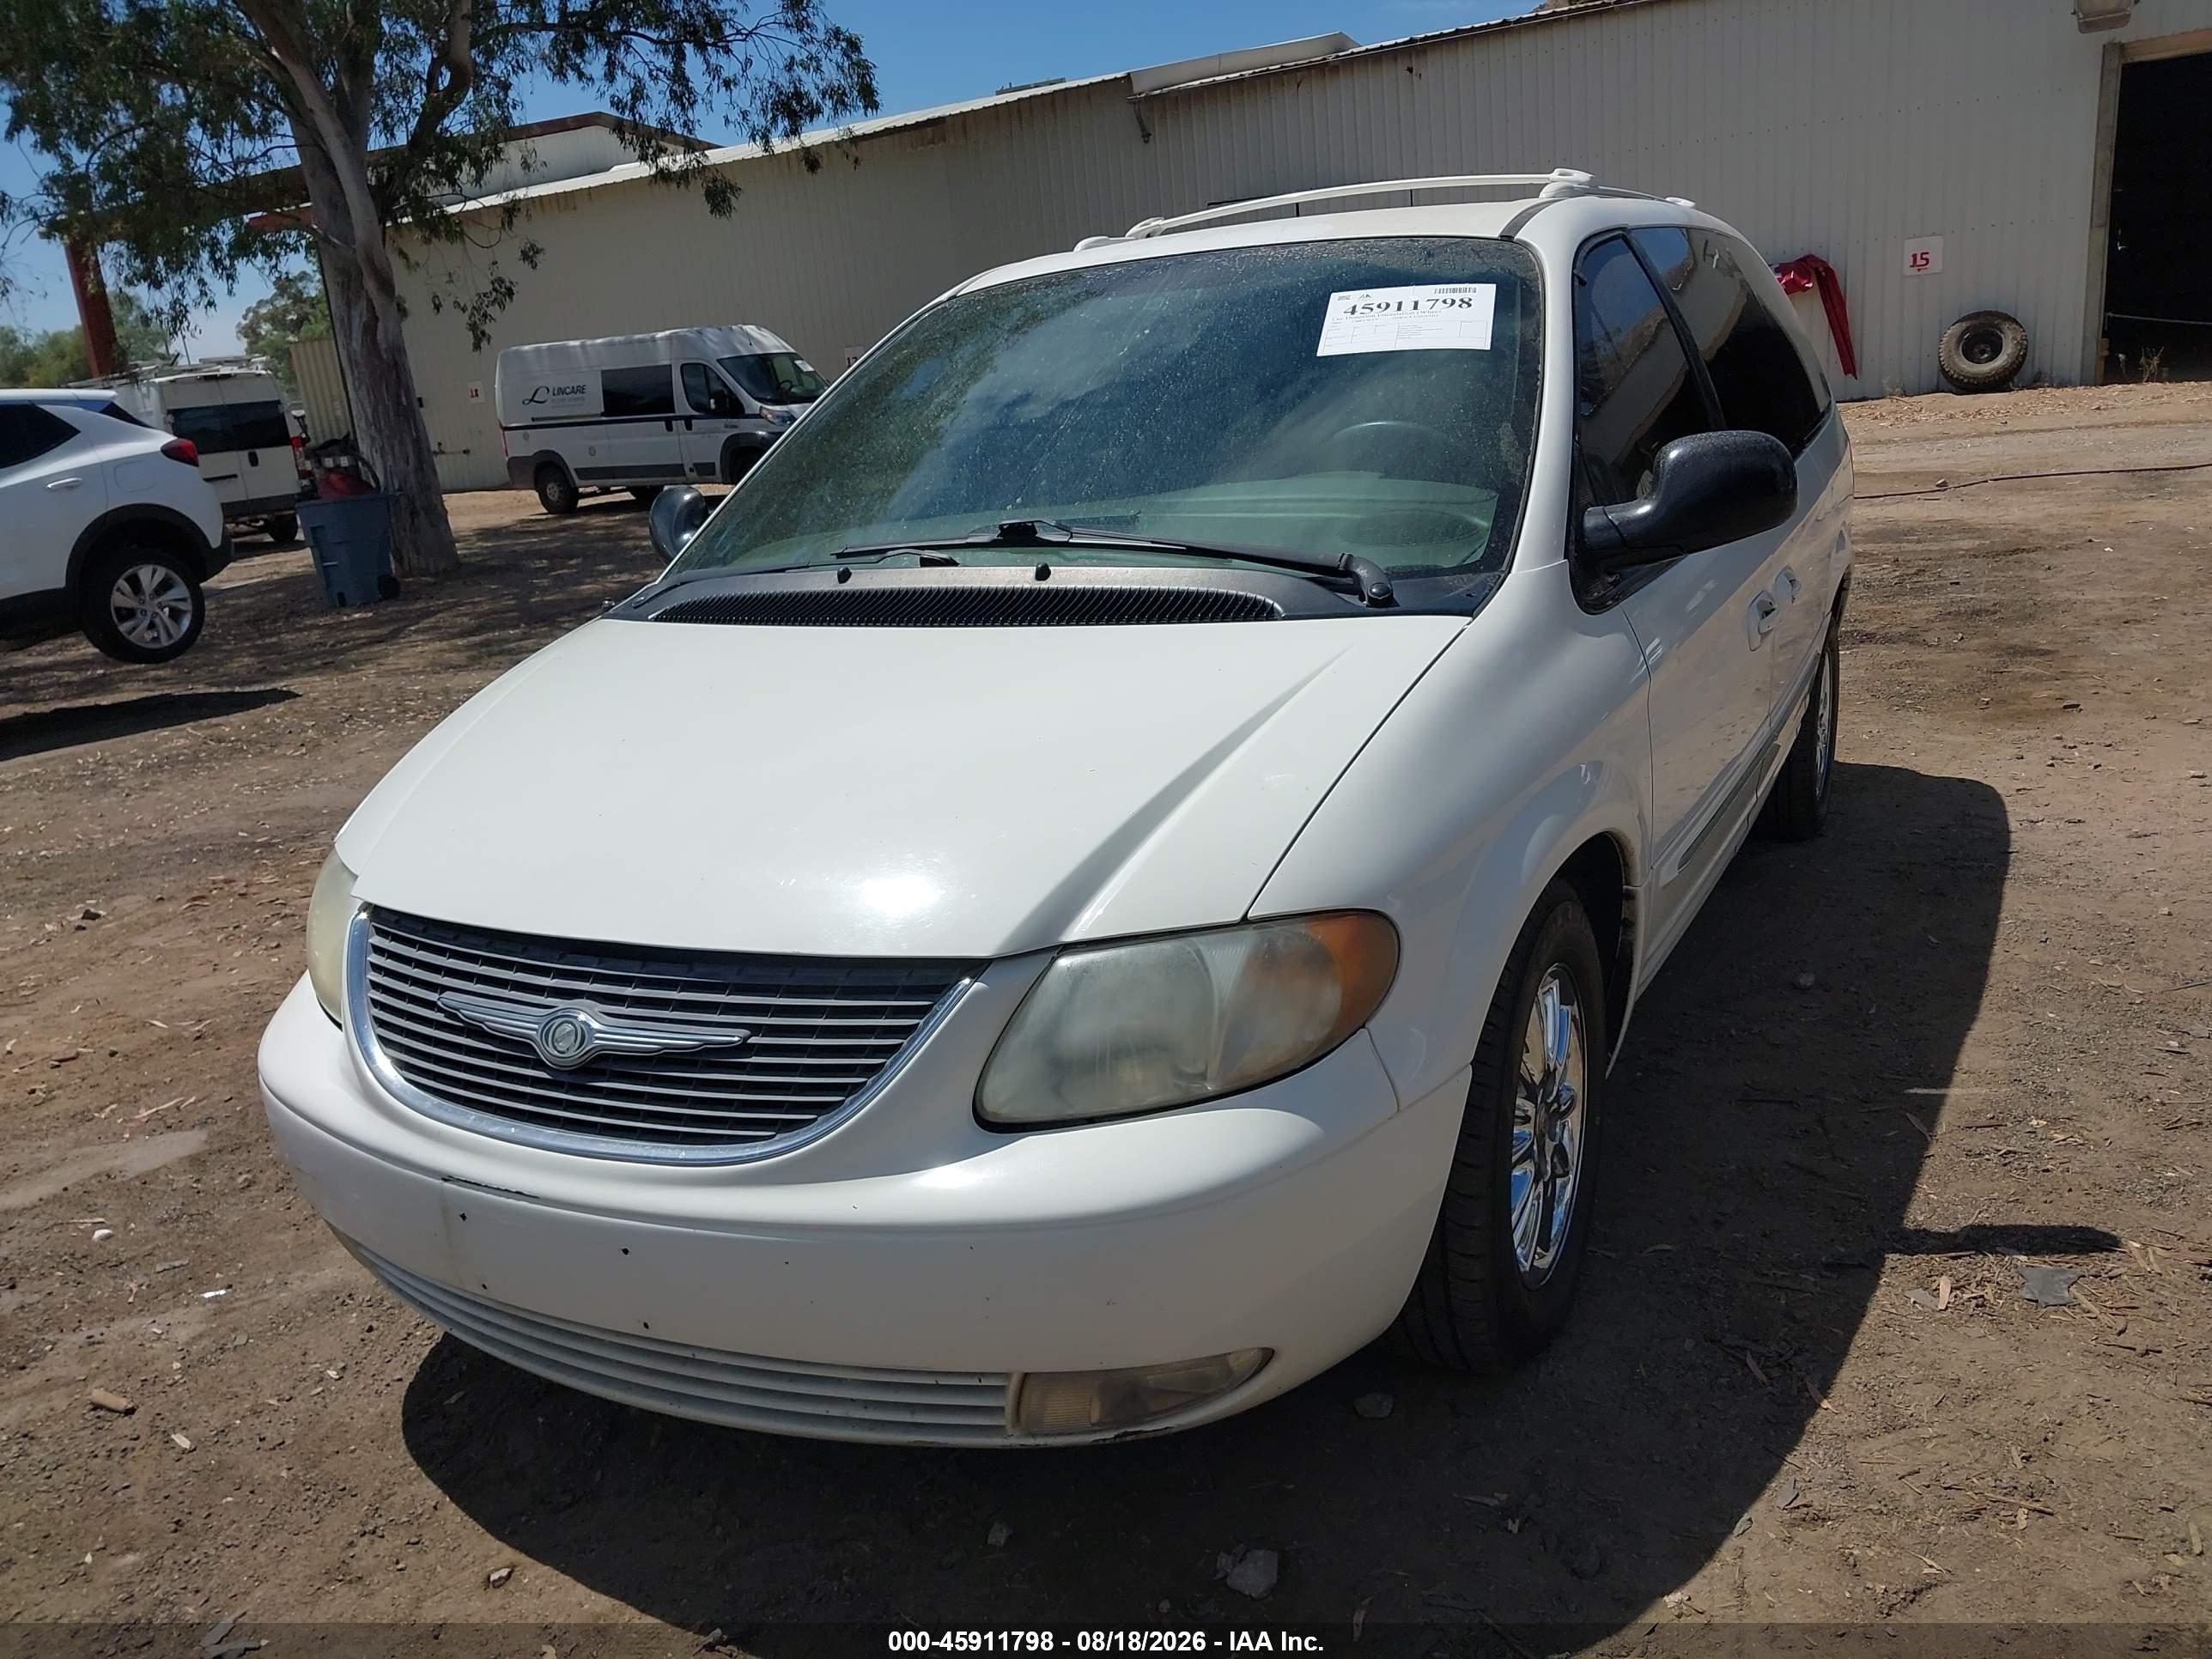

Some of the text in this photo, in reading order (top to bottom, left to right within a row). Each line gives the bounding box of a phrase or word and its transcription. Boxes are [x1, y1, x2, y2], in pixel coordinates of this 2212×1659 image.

[1910, 252, 1930, 268] 15
[1343, 296, 1474, 316] 45911798
[552, 384, 586, 397] LINCARE
